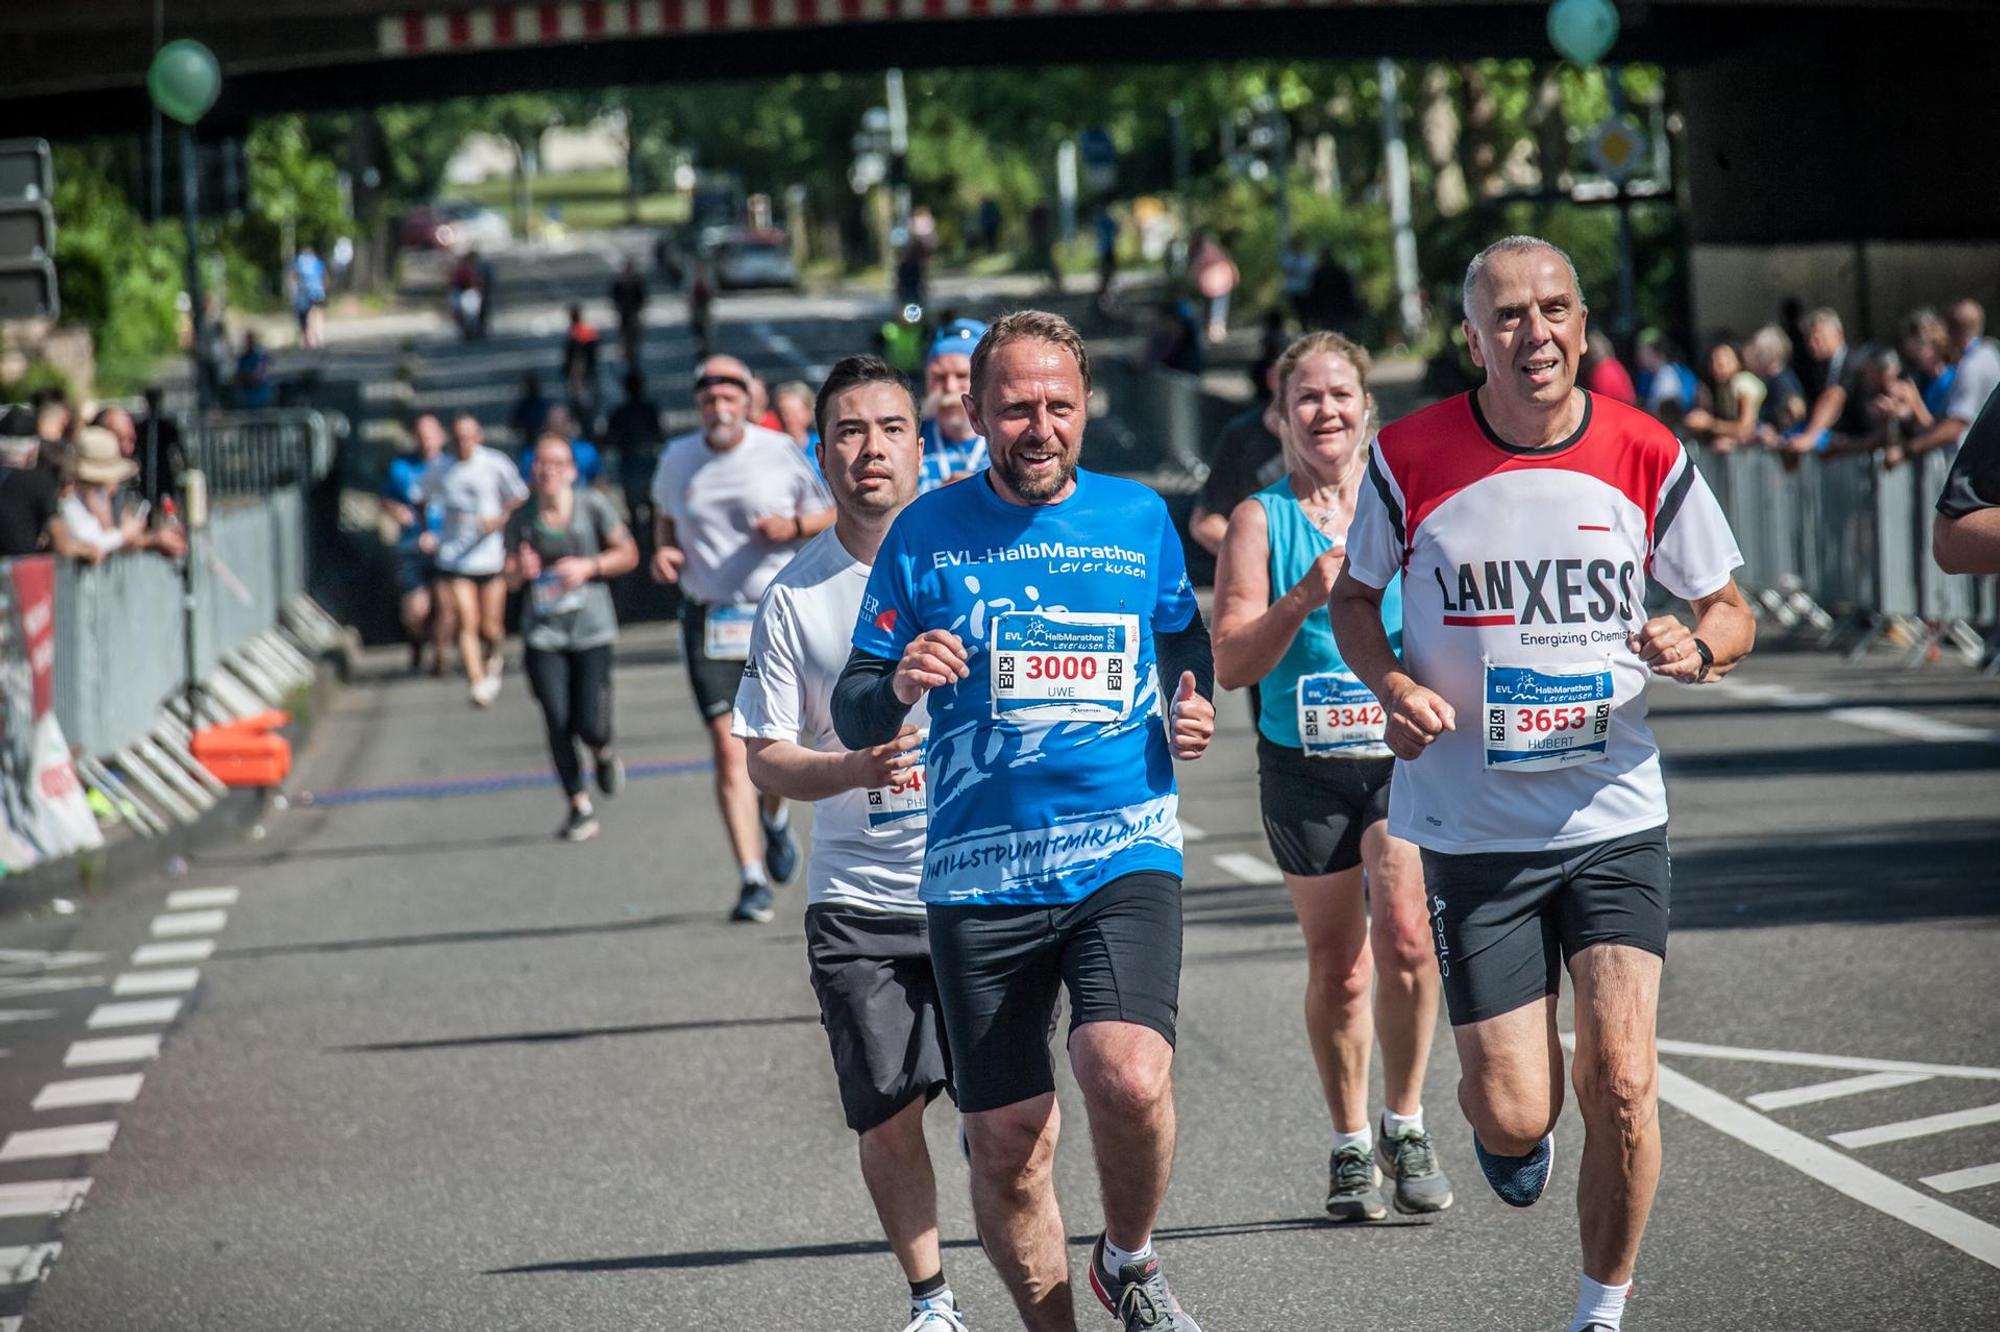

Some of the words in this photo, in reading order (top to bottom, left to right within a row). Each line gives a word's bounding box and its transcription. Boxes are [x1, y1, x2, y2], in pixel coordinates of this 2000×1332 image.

[932, 542, 1146, 569] EVL-HalbMarathon
[1048, 561, 1146, 579] Leverkusen
[1434, 558, 1635, 625] LANXESS
[1005, 632, 1023, 641] EVL
[1045, 633, 1104, 642] HalbMarathon
[1053, 641, 1104, 650] Leverkusen
[1107, 627, 1115, 650] 2022
[1520, 631, 1588, 648] Energizing
[1025, 655, 1098, 680] 3000
[1047, 687, 1076, 698] UWE
[1495, 685, 1513, 694] EVL
[1535, 684, 1593, 694] HalbMarathon
[1596, 675, 1604, 698] 2022
[1543, 693, 1593, 703] Leverkusen
[1327, 706, 1384, 728] 3342
[1516, 706, 1586, 732] 3653
[1528, 736, 1575, 749] HUBERT
